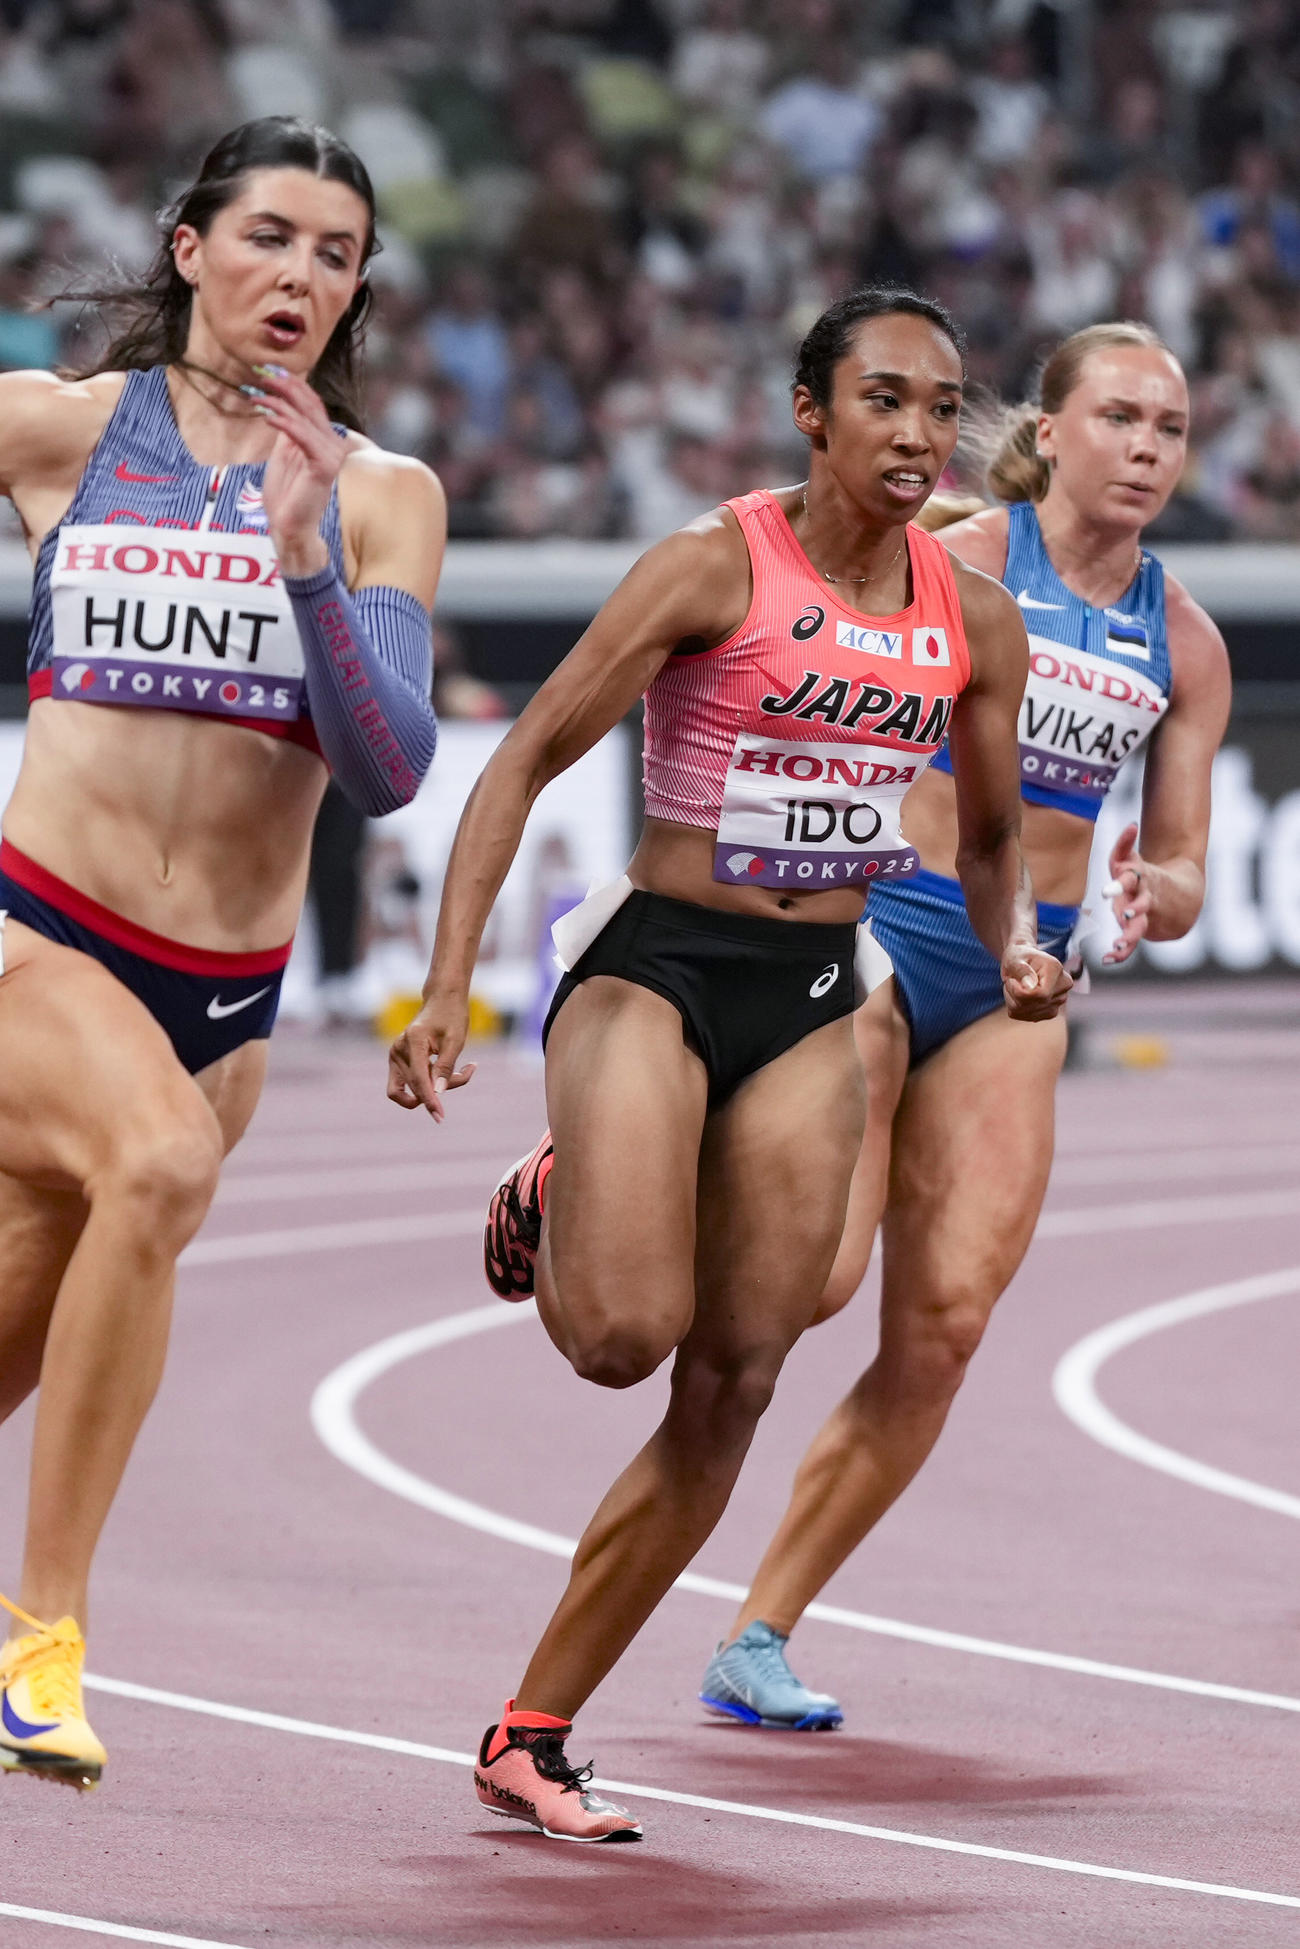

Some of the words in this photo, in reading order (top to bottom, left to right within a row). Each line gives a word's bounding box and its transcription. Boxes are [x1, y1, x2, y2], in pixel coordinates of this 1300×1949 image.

[84, 596, 279, 663] HUNT
[317, 601, 370, 691] GREAT
[839, 626, 900, 655] ACN
[760, 670, 952, 745] JAPAN
[1028, 652, 1160, 714] ONDA
[1027, 697, 1140, 763] VIKAS
[734, 748, 918, 788] HONDA
[784, 799, 883, 845] IDO
